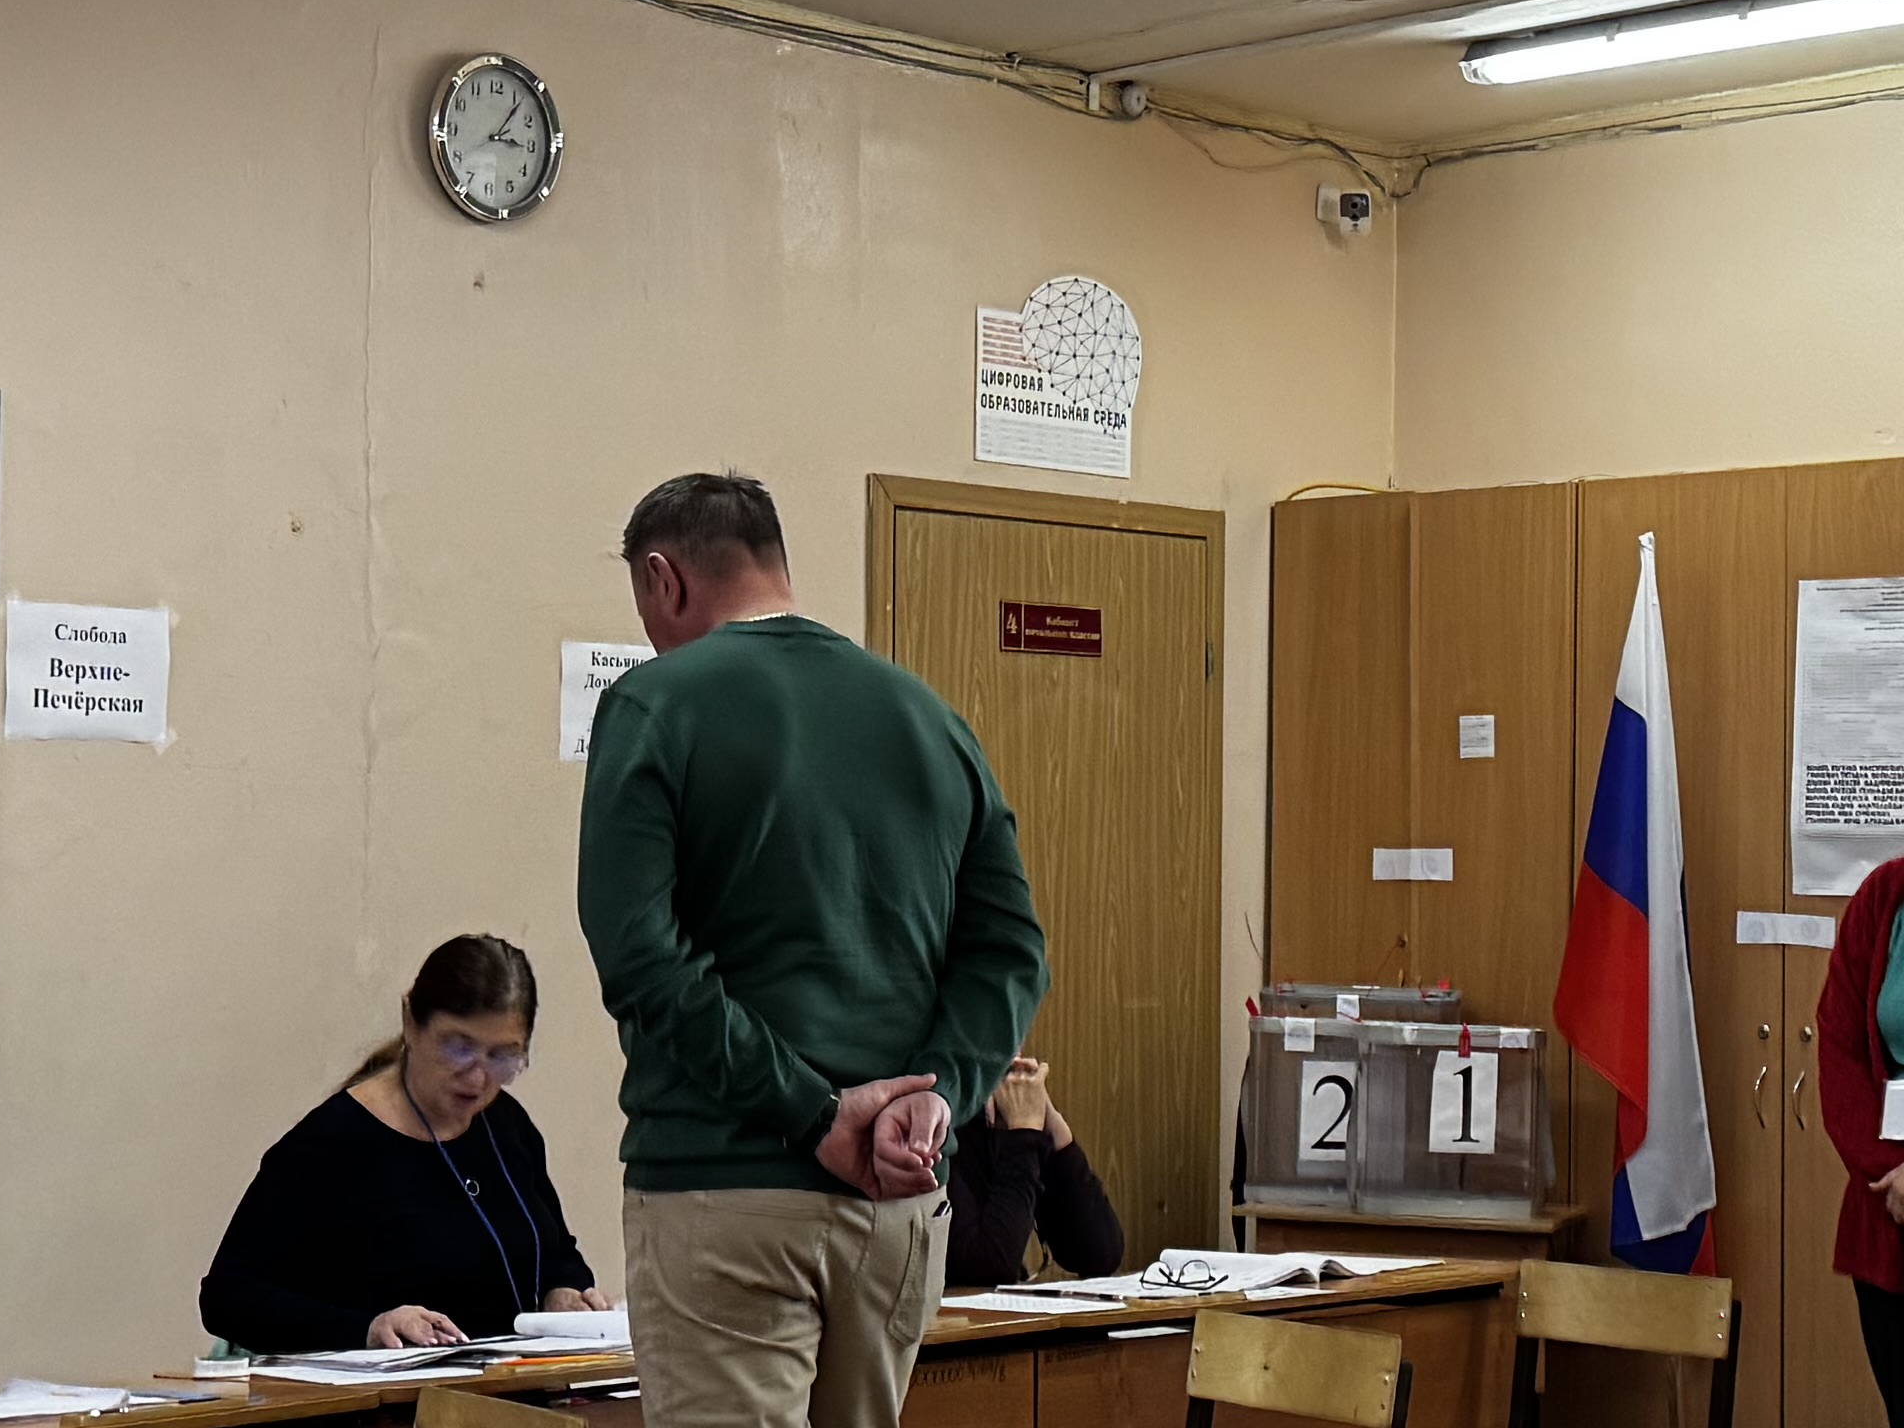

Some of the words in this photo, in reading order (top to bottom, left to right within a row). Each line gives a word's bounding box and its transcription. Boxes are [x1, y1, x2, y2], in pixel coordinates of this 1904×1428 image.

[471, 80, 481, 97] 11
[490, 79, 504, 95] 12
[456, 96, 466, 112] 10
[524, 115, 533, 129] 2
[526, 139, 536, 153] 3
[452, 150, 462, 163] 8
[519, 161, 527, 177] 4
[465, 171, 475, 185] 7
[484, 182, 494, 197] 6
[505, 180, 514, 193] 5
[980, 369, 1044, 392] ЦИФРОВАЯ
[980, 393, 1090, 422] ОБРАЗОВАТЕЛЬНАЯ
[1093, 409, 1128, 429] СРЕДА
[1006, 613, 1018, 634] 4
[54, 623, 127, 645] Слобода
[49, 657, 131, 685] Верхне-
[33, 687, 144, 717] Печёрская
[1311, 1074, 1354, 1150] 2
[1452, 1065, 1481, 1143] 1
